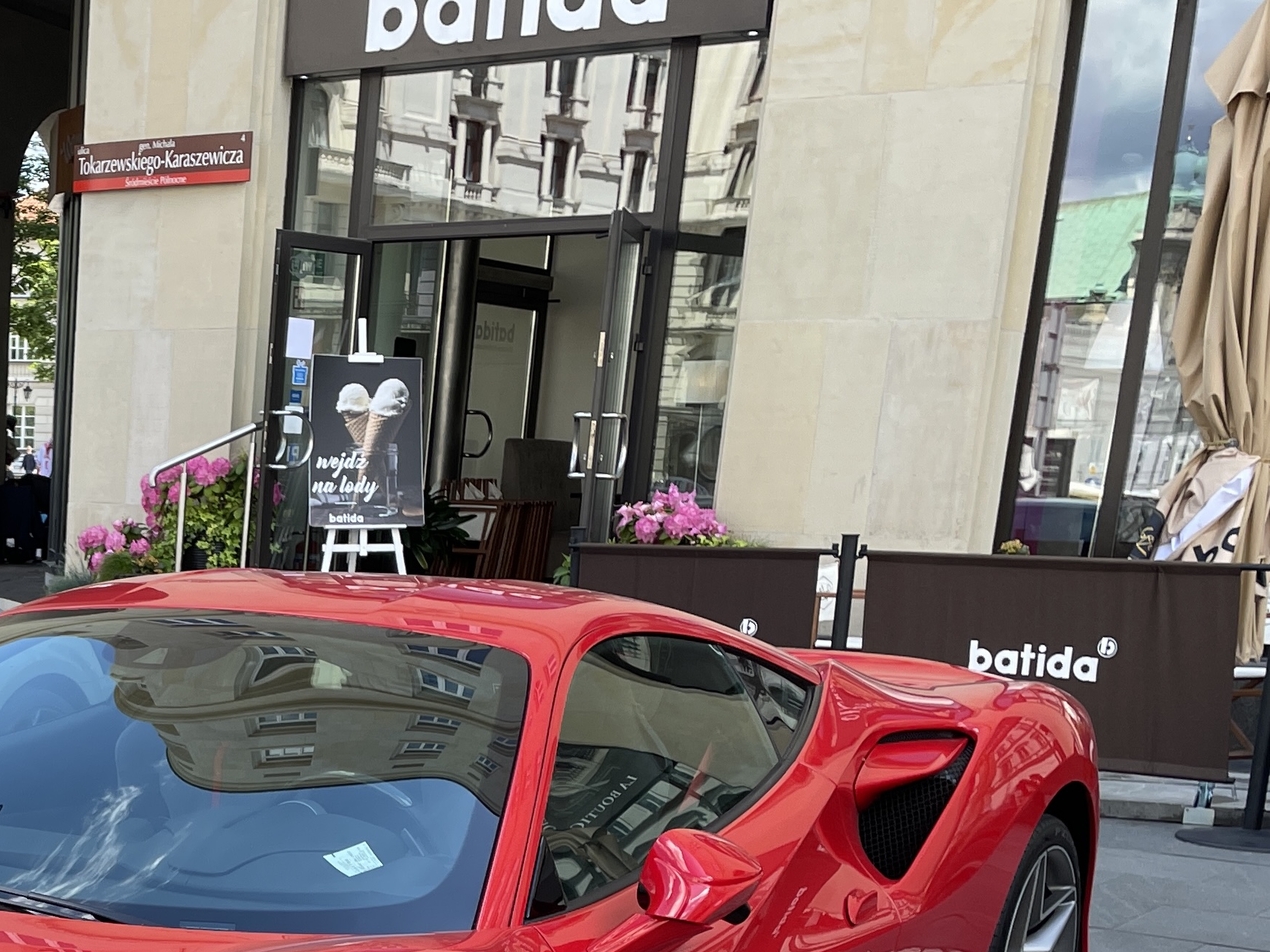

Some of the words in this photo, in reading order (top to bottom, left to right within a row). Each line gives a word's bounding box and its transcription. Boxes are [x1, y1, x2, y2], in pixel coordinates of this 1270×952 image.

[240, 133, 246, 142] 4
[77, 146, 90, 155] ulica
[138, 143, 151, 152] gen.
[78, 145, 244, 176] Tokarzewskiego-Karaszewicza
[312, 480, 336, 494] na
[339, 475, 379, 501] lody
[328, 512, 364, 524] batida
[968, 639, 1100, 683] batida
